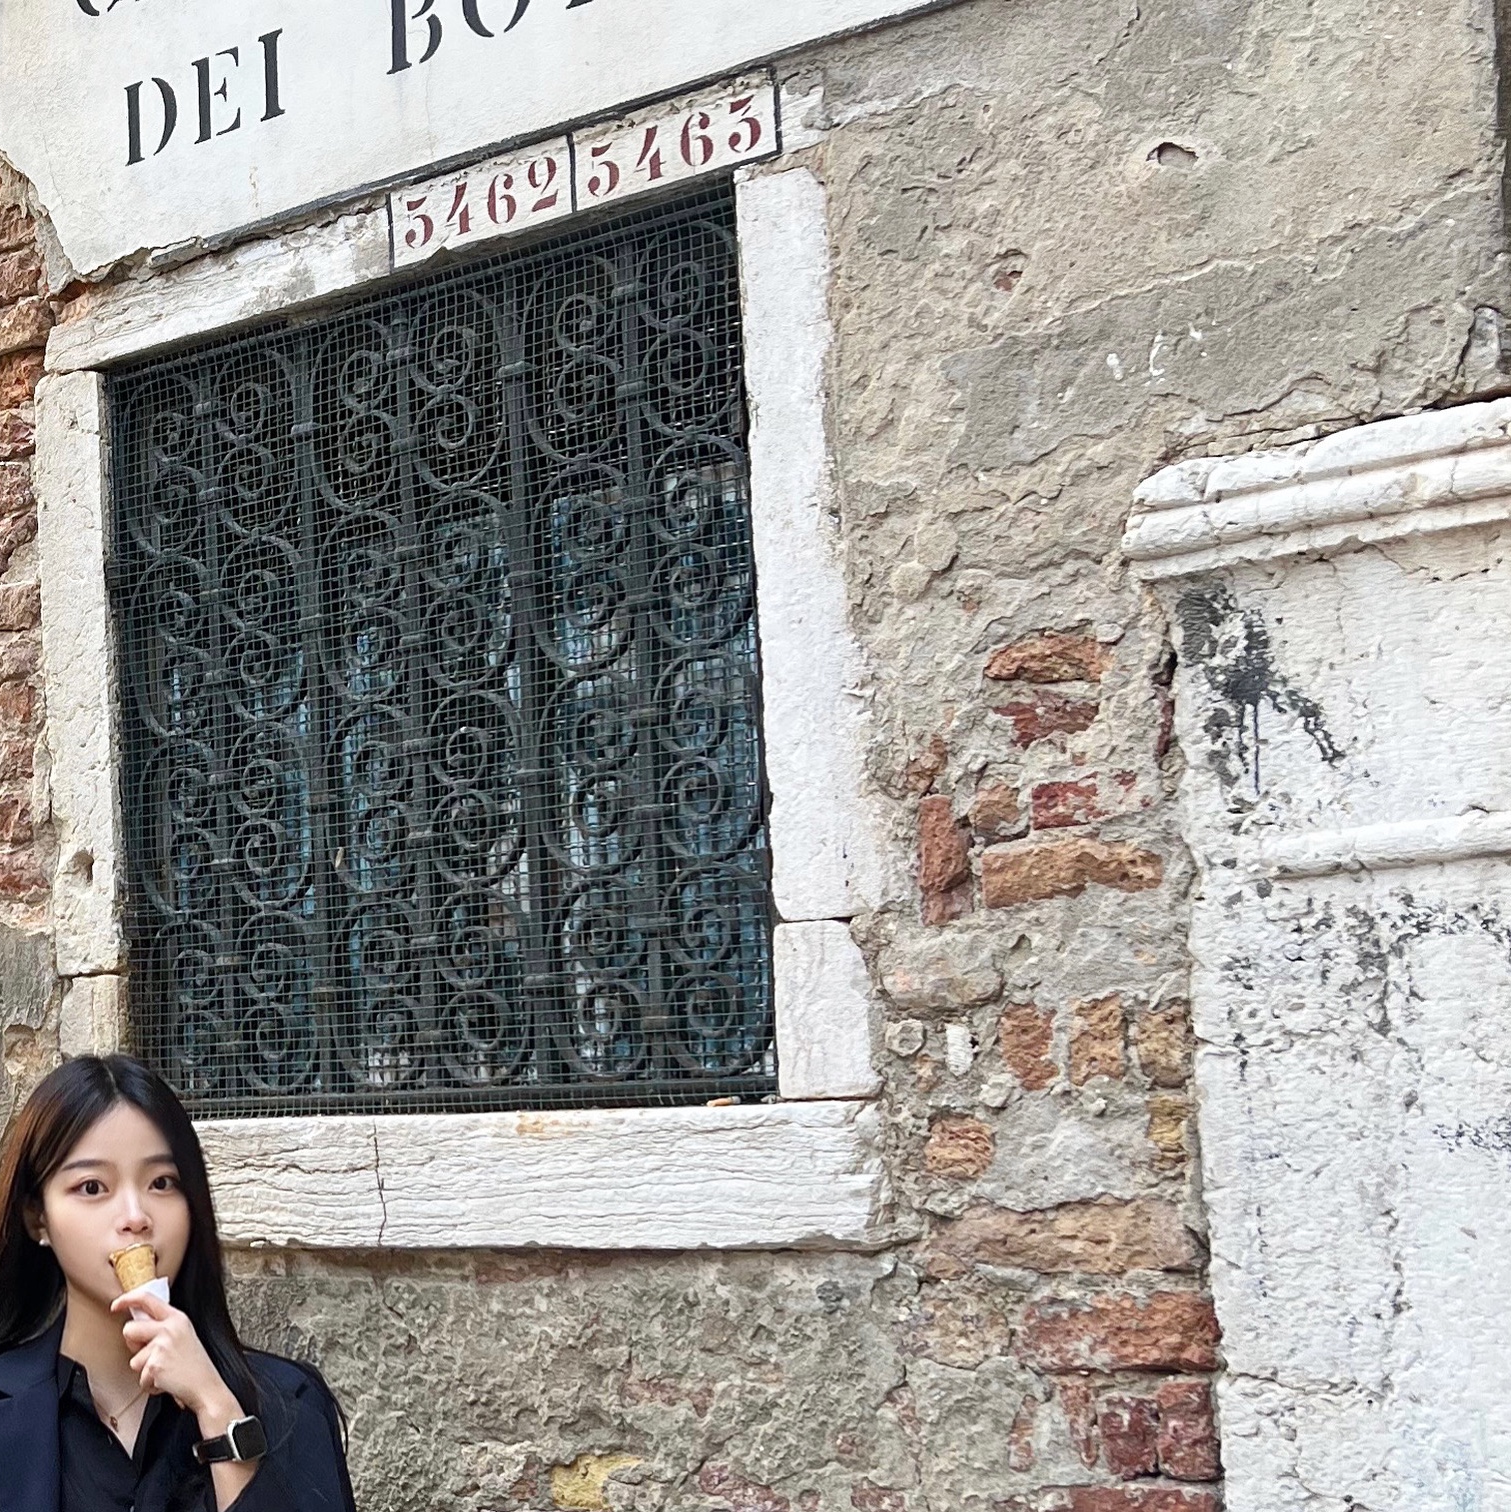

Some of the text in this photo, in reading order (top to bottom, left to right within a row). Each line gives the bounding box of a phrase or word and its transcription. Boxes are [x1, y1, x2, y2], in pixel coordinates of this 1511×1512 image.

[123, 28, 286, 167] DEI
[587, 94, 762, 198] 5463
[404, 156, 558, 250] 5462
